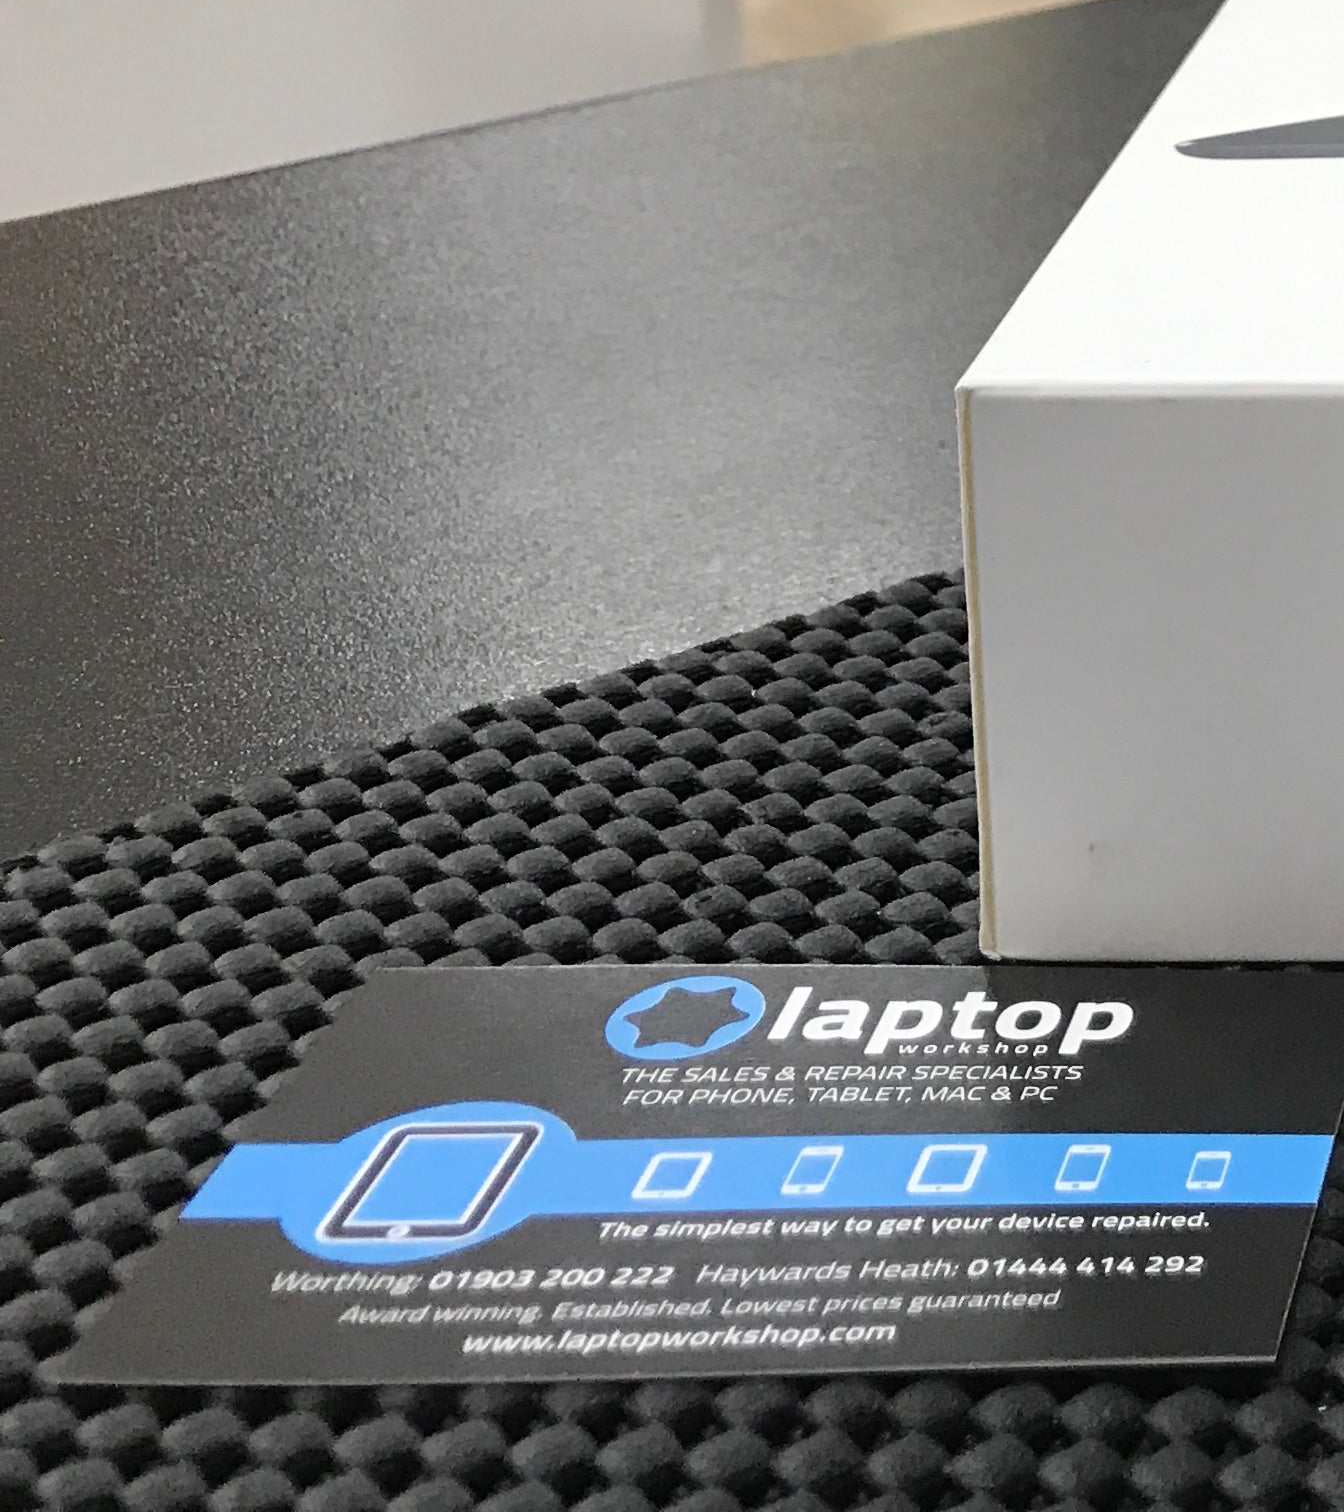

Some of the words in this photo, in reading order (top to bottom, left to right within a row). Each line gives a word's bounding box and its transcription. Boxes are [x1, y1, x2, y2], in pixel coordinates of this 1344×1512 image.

[766, 985, 1134, 1056] laptop
[898, 1040, 1049, 1058] workshop
[621, 1067, 678, 1084] THE
[681, 1066, 769, 1083] SALES
[775, 1065, 797, 1082] &
[804, 1064, 907, 1082] REPAIR
[911, 1063, 1085, 1081] SPECIALISTS
[621, 1088, 683, 1106] FOR
[689, 1087, 796, 1107] PHONE,
[807, 1086, 914, 1105] TABLET,
[920, 1085, 984, 1103] MAC
[990, 1085, 1013, 1102] &
[1018, 1084, 1059, 1102] PC
[599, 1220, 649, 1240] The
[653, 1218, 775, 1242] simplest
[780, 1218, 835, 1240] way
[844, 1215, 873, 1234] to
[876, 1216, 925, 1237] get
[930, 1215, 994, 1234] your
[998, 1212, 1083, 1231] device
[1090, 1211, 1211, 1232] repaired.
[427, 1268, 536, 1290] 01903
[538, 1267, 607, 1289] 200
[609, 1266, 676, 1287] 222
[696, 1261, 852, 1288] Haywards
[859, 1259, 958, 1281] Heath:
[966, 1256, 1068, 1278] 01444
[1075, 1255, 1137, 1276] 414
[1144, 1254, 1206, 1275] 292
[337, 1303, 433, 1325] Award
[720, 1294, 819, 1318] Lowest
[820, 1291, 905, 1317] prices
[906, 1288, 1063, 1315] guaranteed
[461, 1322, 898, 1357] www.laptopworkshop.com
